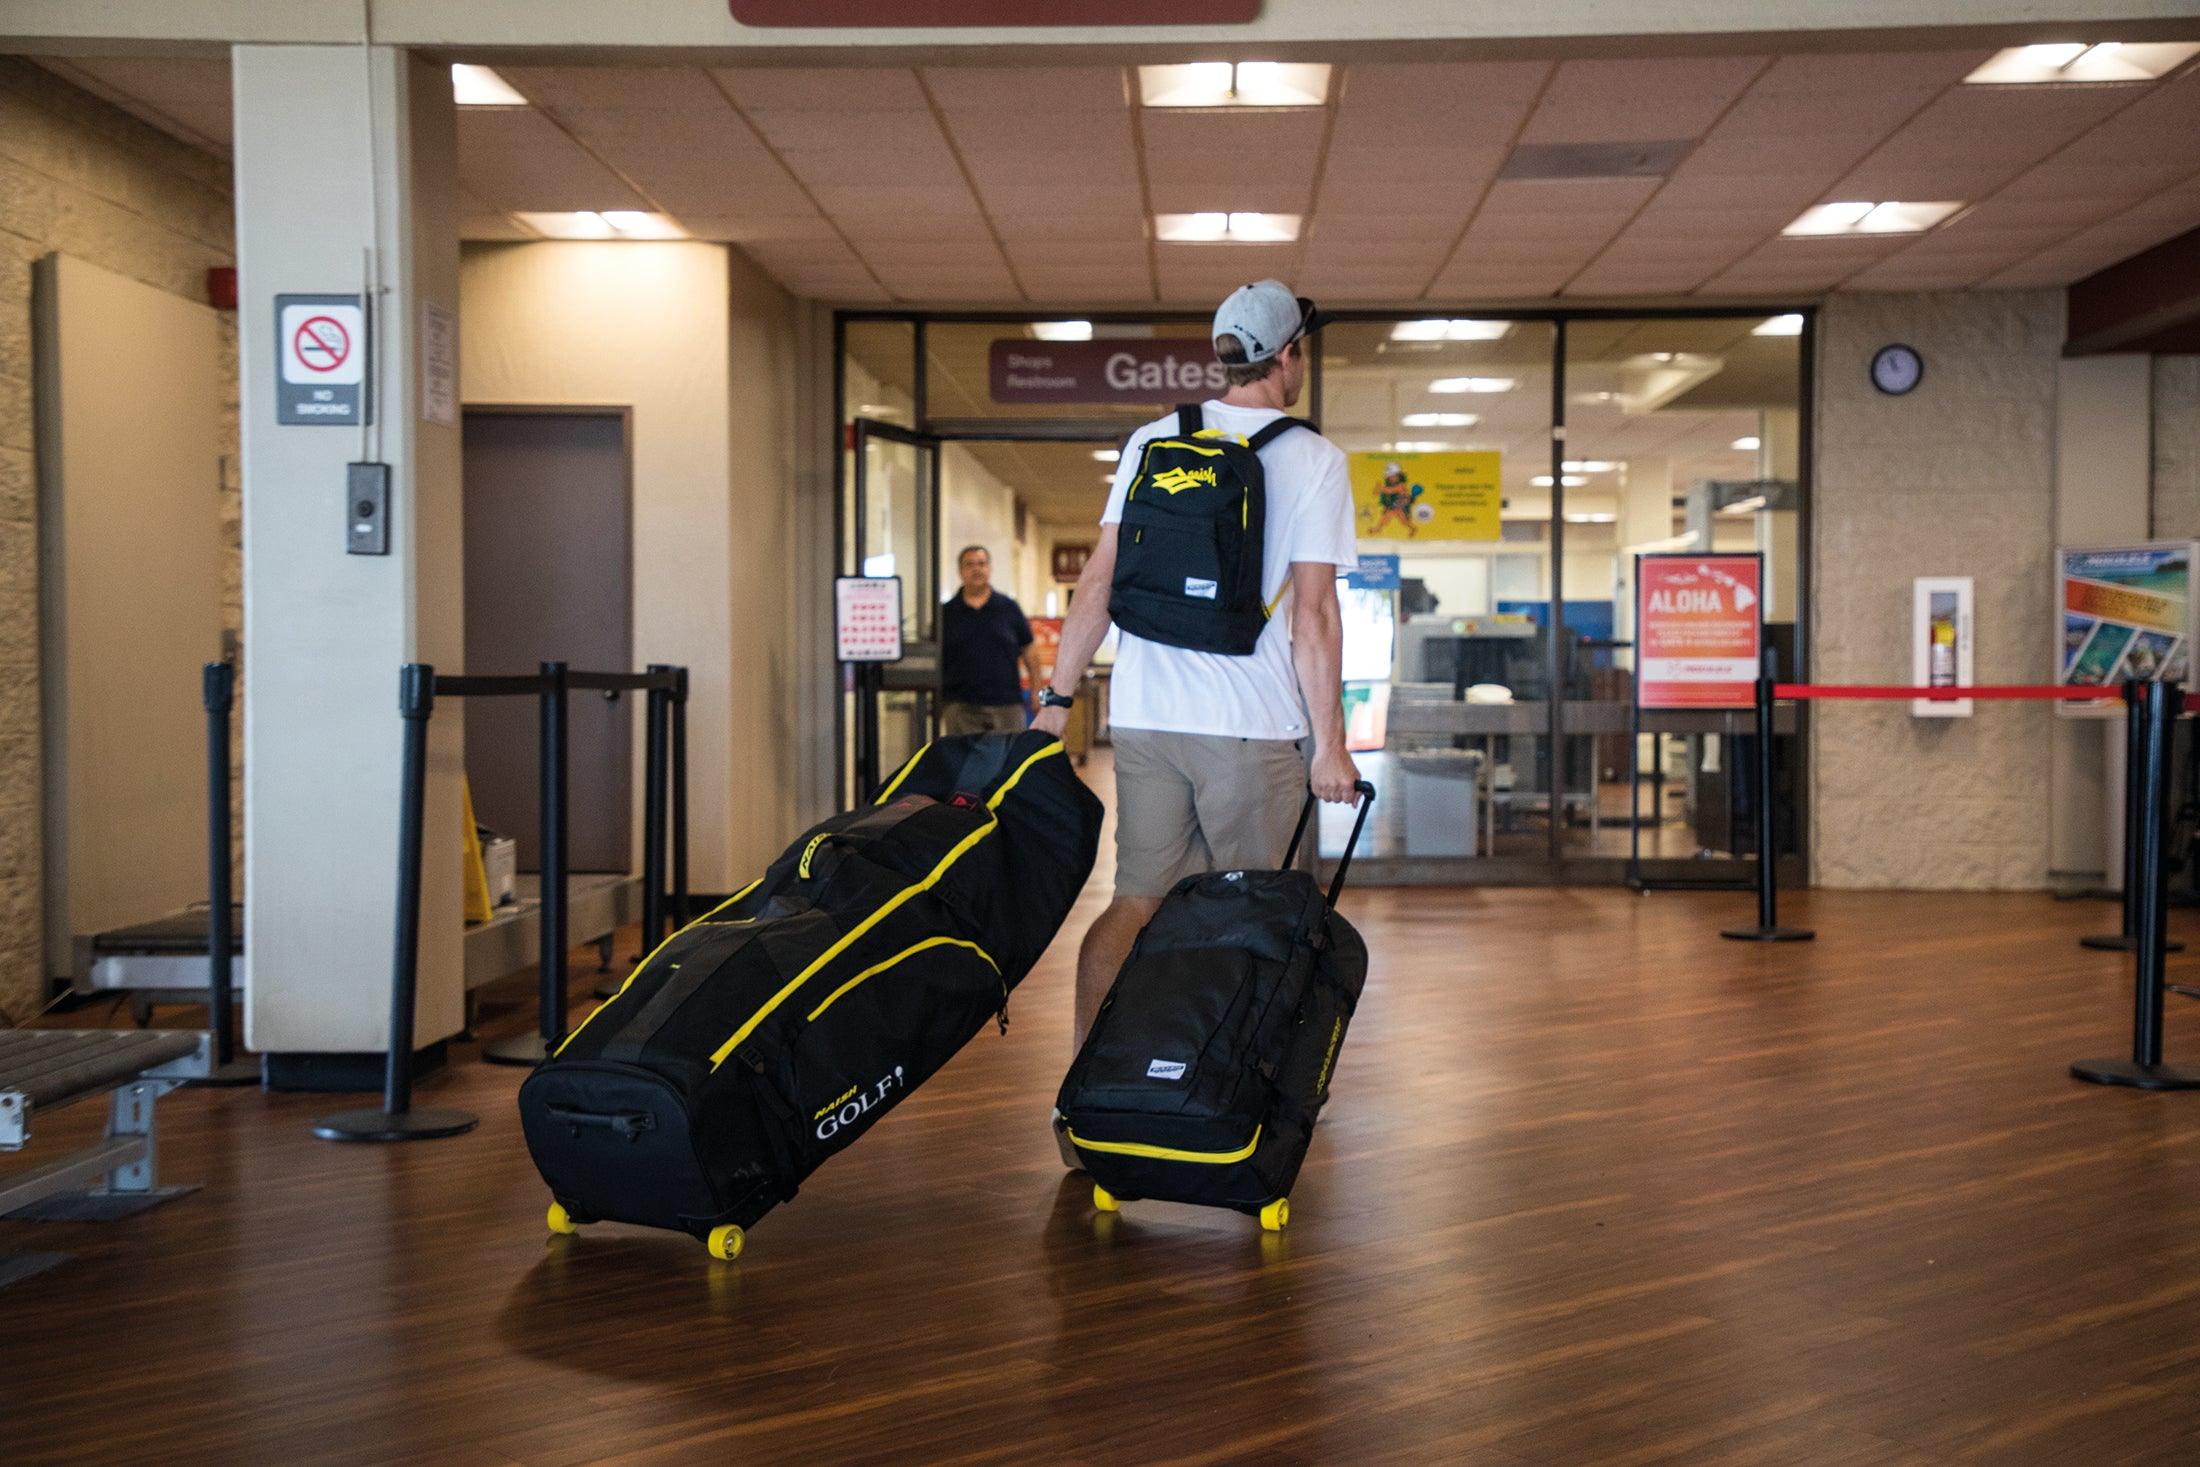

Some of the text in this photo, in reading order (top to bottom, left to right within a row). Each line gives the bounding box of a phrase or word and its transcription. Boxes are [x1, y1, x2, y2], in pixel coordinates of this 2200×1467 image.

[1105, 352, 1228, 390] Gates
[296, 403, 350, 415] SMOKING
[313, 390, 333, 401] NO
[1648, 589, 1722, 613] ALOHA
[814, 1084, 858, 1120] NAISH
[816, 1074, 892, 1140] GOLF
